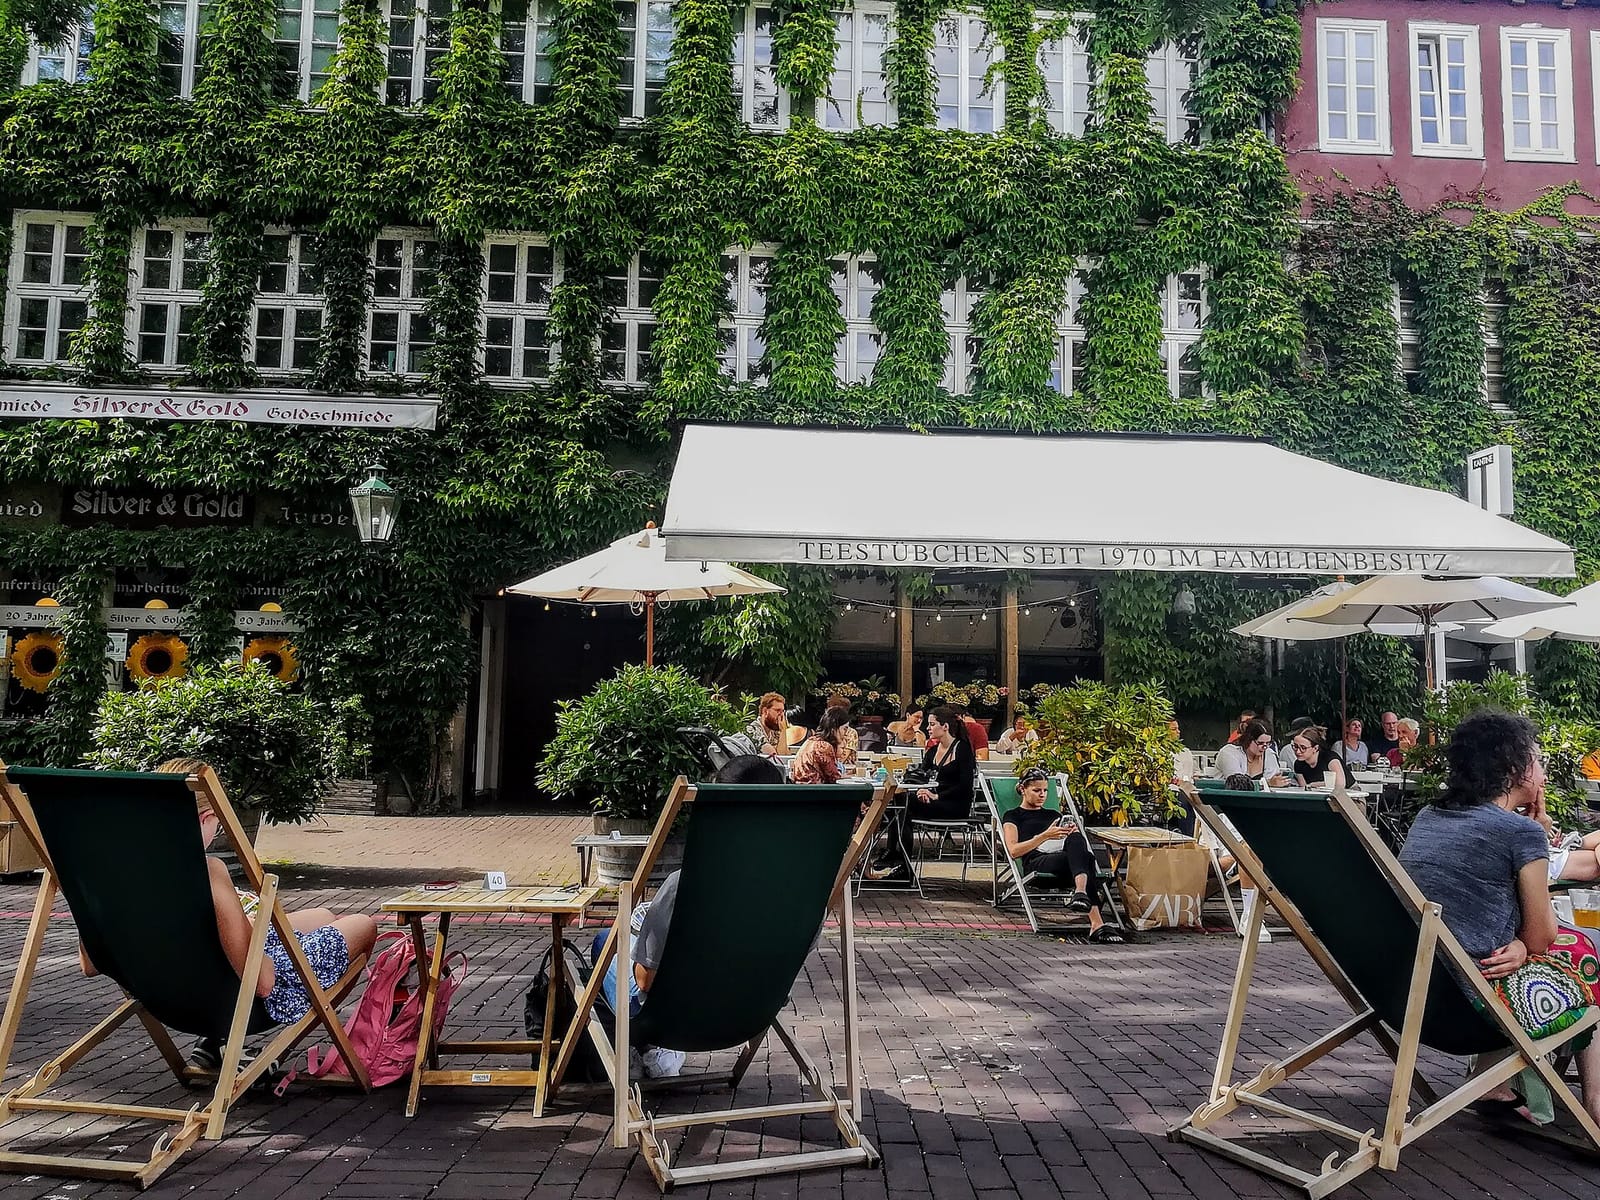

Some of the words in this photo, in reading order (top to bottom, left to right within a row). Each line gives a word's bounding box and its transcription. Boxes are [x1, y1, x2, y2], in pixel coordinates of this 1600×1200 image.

[267, 408, 393, 424] Goldschmiede
[72, 489, 151, 515] Silver
[155, 493, 177, 516] &
[183, 493, 244, 518] Gold
[799, 542, 1010, 564] TEESTÜBCHEN
[1022, 546, 1086, 565] SEIT
[1101, 548, 1156, 566] 1970
[1168, 550, 1203, 567] IM
[1213, 551, 1450, 571] FAMILIENBESITZ
[6, 612, 20, 620] 20
[24, 612, 54, 622] Jahre
[110, 614, 140, 623] Silver
[145, 615, 156, 624] &
[239, 617, 253, 625] 20
[492, 876, 503, 885] 40
